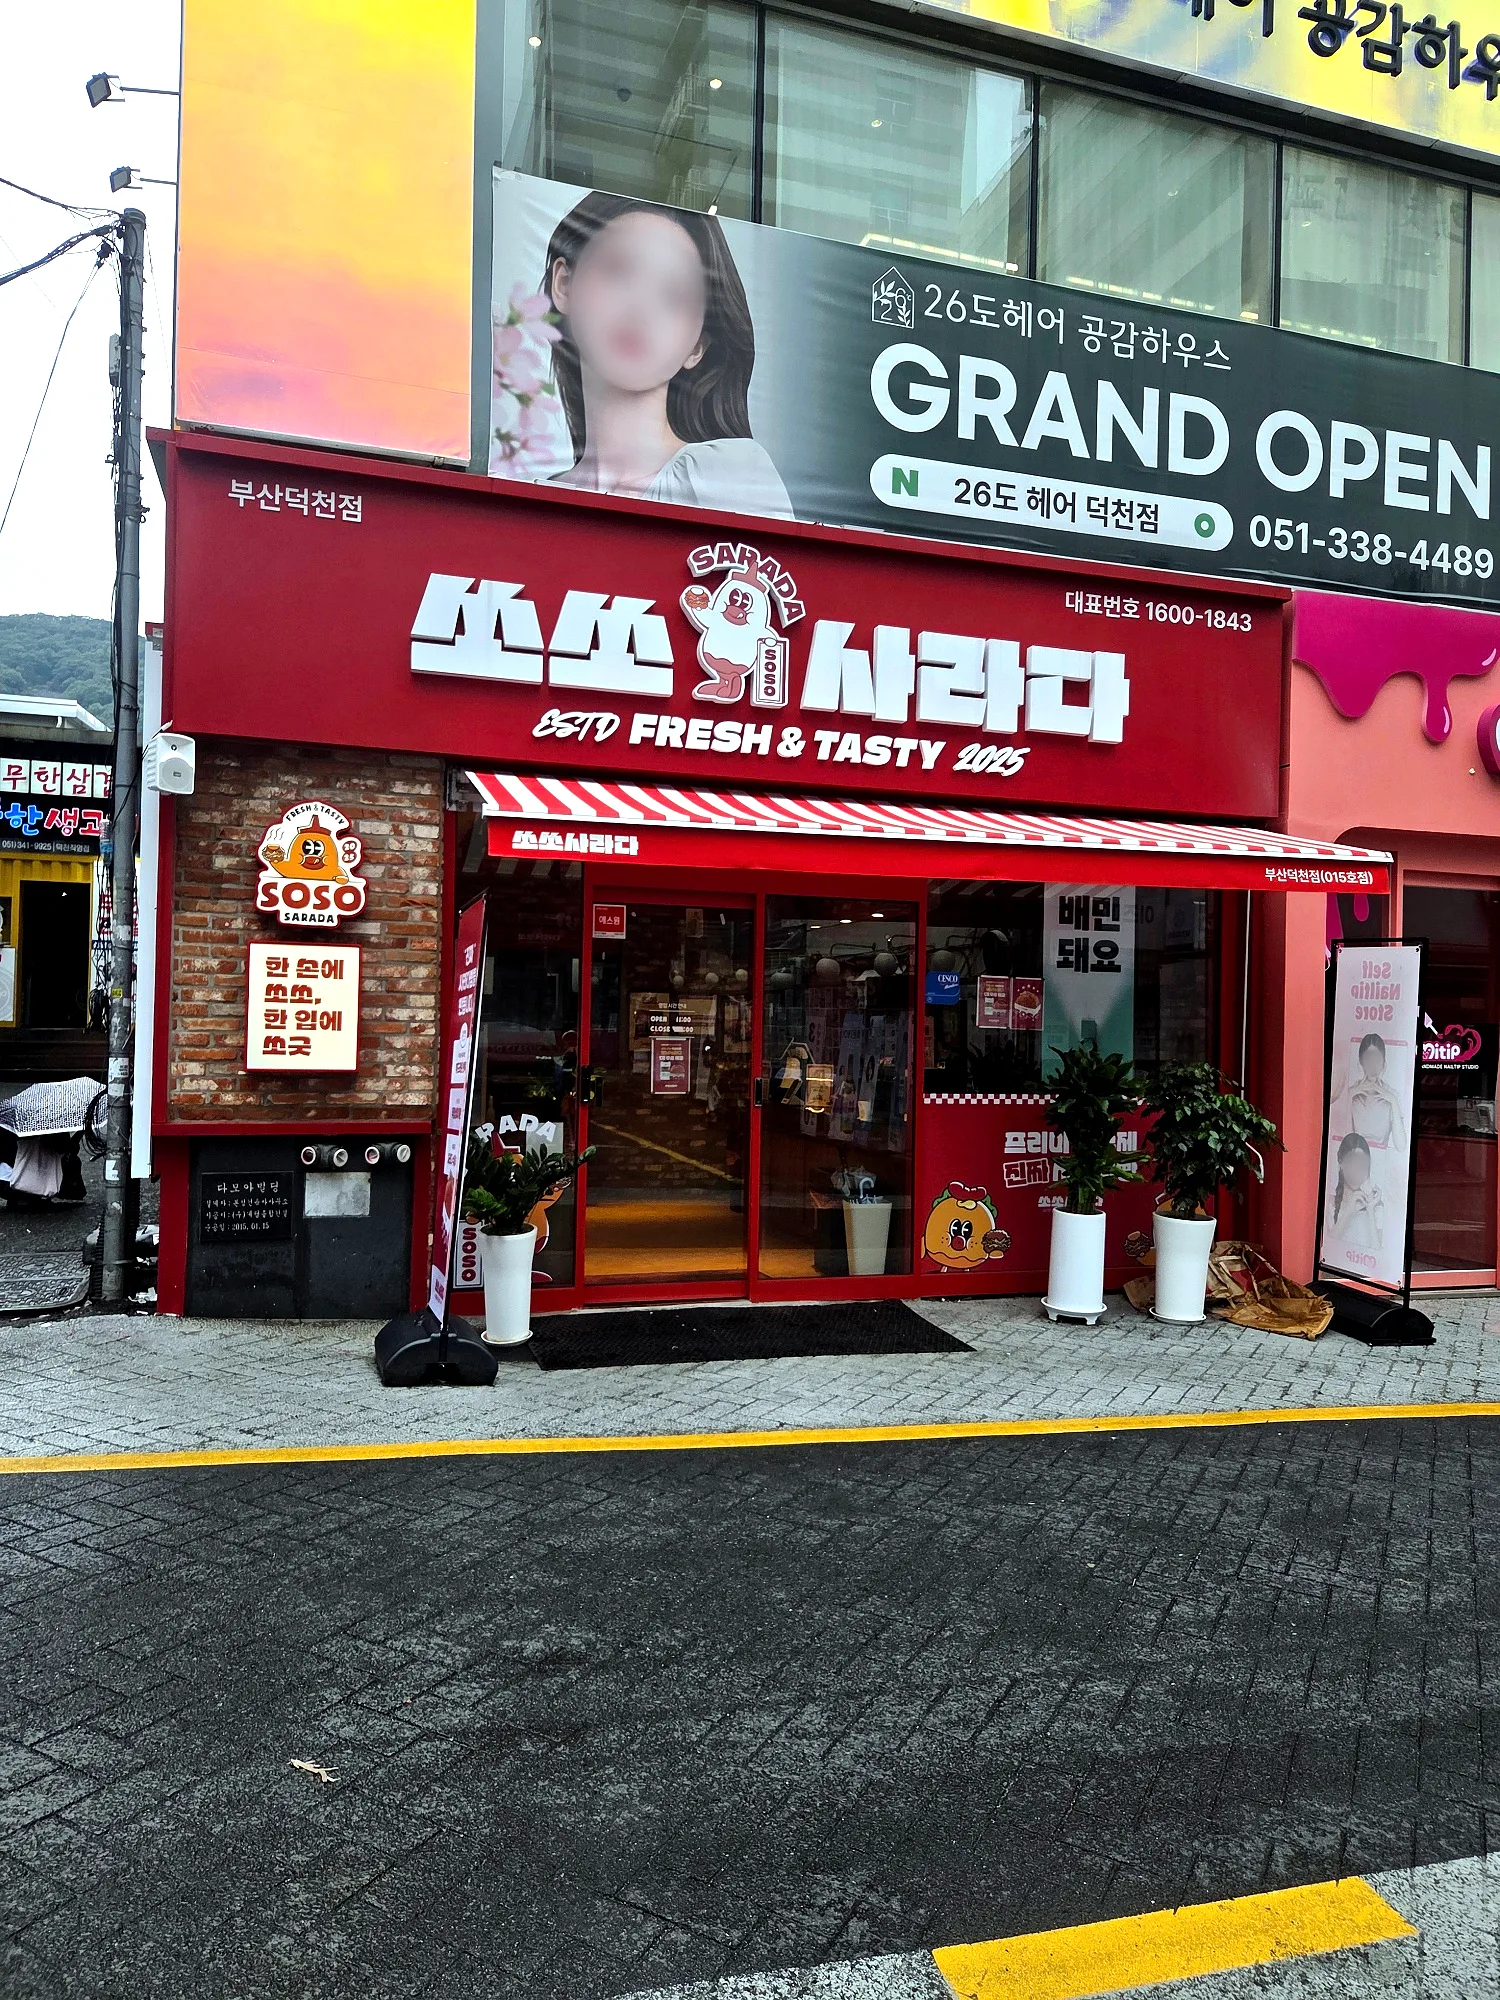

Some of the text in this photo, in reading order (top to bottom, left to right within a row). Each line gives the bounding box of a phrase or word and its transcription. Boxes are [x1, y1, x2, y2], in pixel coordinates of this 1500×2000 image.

[923, 283, 1233, 371] 26도헤어 공감하우스
[870, 342, 1491, 520] GRAND OPEN
[227, 479, 364, 524] 부산덕천점
[953, 478, 1160, 535] 26도 헤어 덕천점
[1249, 514, 1495, 579] 051-338-4489
[689, 543, 806, 626] SARADA
[1065, 591, 1252, 632] 대표번호 1600-1843
[410, 572, 1131, 744] 쏘쏘 사라다
[763, 648, 777, 697] SOSO
[531, 708, 1031, 777] ESTD FRESH & TASTY 2025
[285, 804, 312, 822] FRESH
[320, 805, 345, 825] TASTY
[511, 830, 639, 856] 쏘쏘사라다
[1264, 867, 1374, 885] 부산덕천점(015호점)
[260, 881, 362, 912] SOSO
[1058, 894, 1121, 932] 배민
[284, 912, 335, 924] SARADA
[265, 956, 345, 980] 한 손에
[1056, 937, 1122, 974] 돼요
[263, 983, 322, 1005] 쏘쏘,
[937, 974, 958, 983] CESCO
[263, 1008, 343, 1032] 한 입에
[262, 1035, 312, 1057] 쏘굿
[475, 1113, 557, 1143] RADA
[1004, 1130, 1070, 1154] 프리미
[461, 1227, 477, 1282] SOSO
